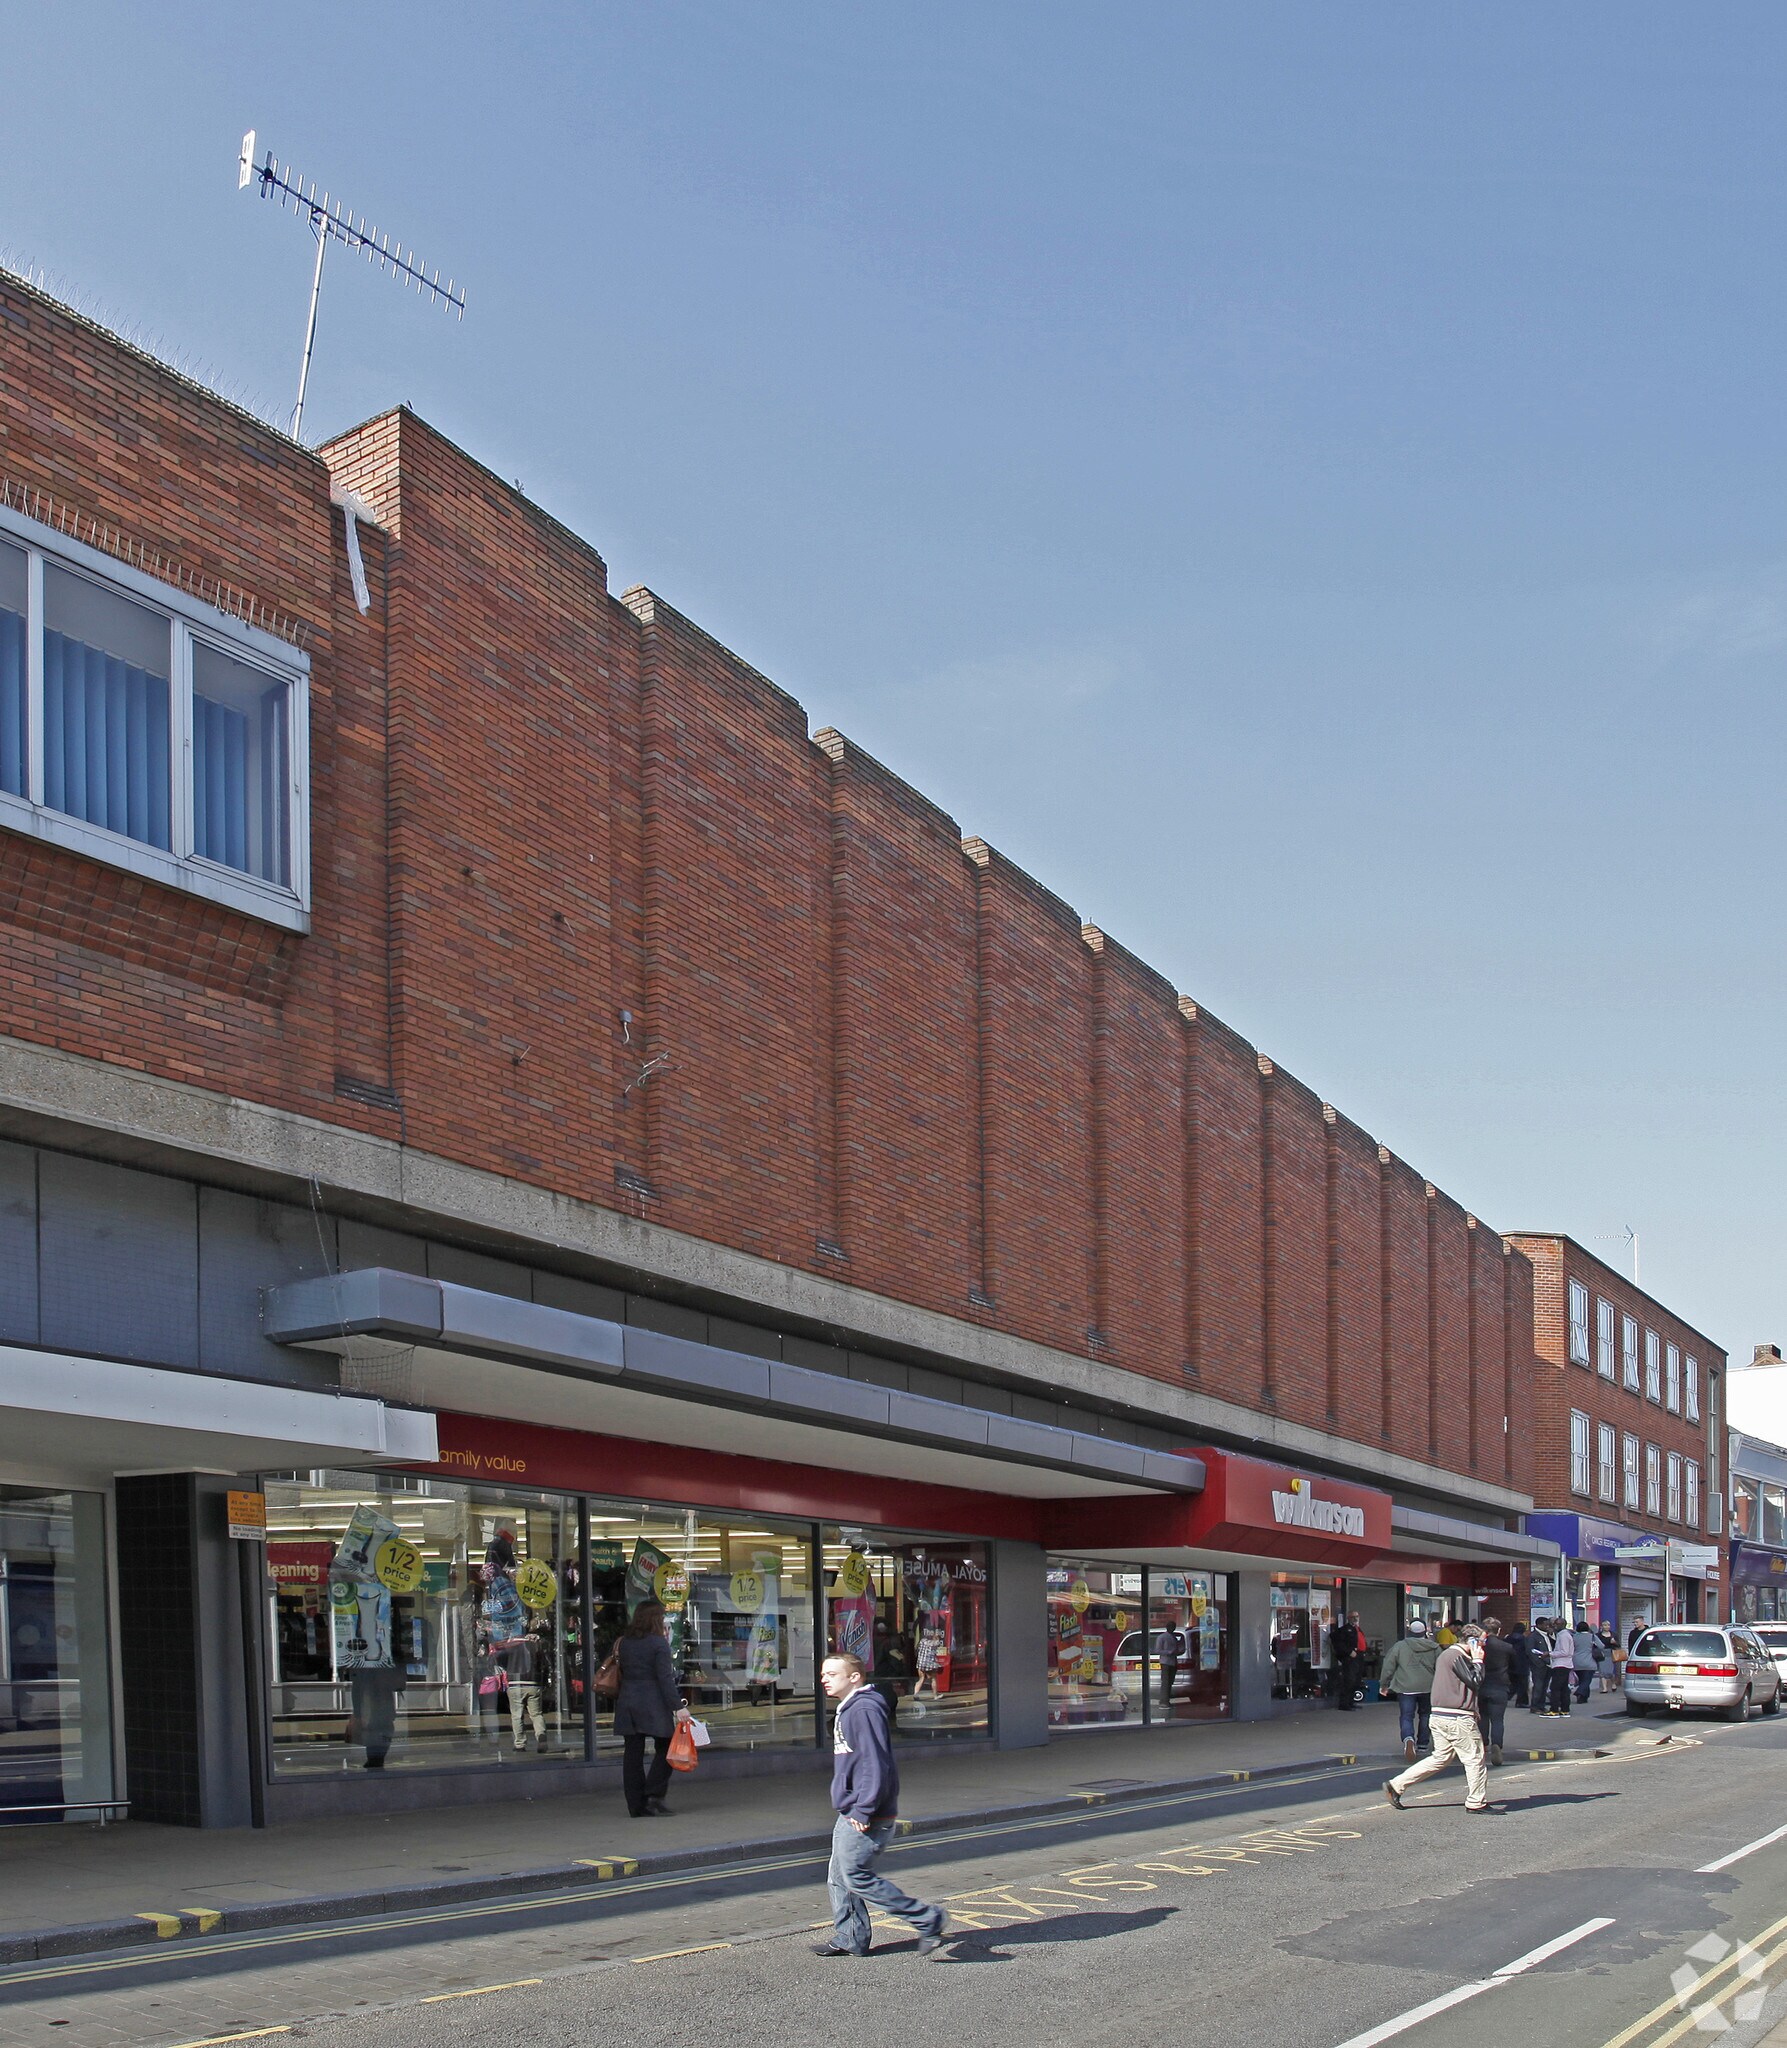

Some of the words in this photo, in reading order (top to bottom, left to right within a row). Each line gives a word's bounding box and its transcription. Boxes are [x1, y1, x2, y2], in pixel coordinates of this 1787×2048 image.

[484, 1455, 526, 1473] value
[1271, 1478, 1365, 1537] wilkinson
[389, 1547, 415, 1571] 1/2
[267, 1560, 320, 1582] leaning
[383, 1566, 411, 1582] price
[527, 1566, 550, 1589] 1/2
[850, 1559, 866, 1578] 1/2
[522, 1583, 548, 1600] price
[736, 1577, 756, 1593] 1/2
[738, 1593, 758, 1605] price
